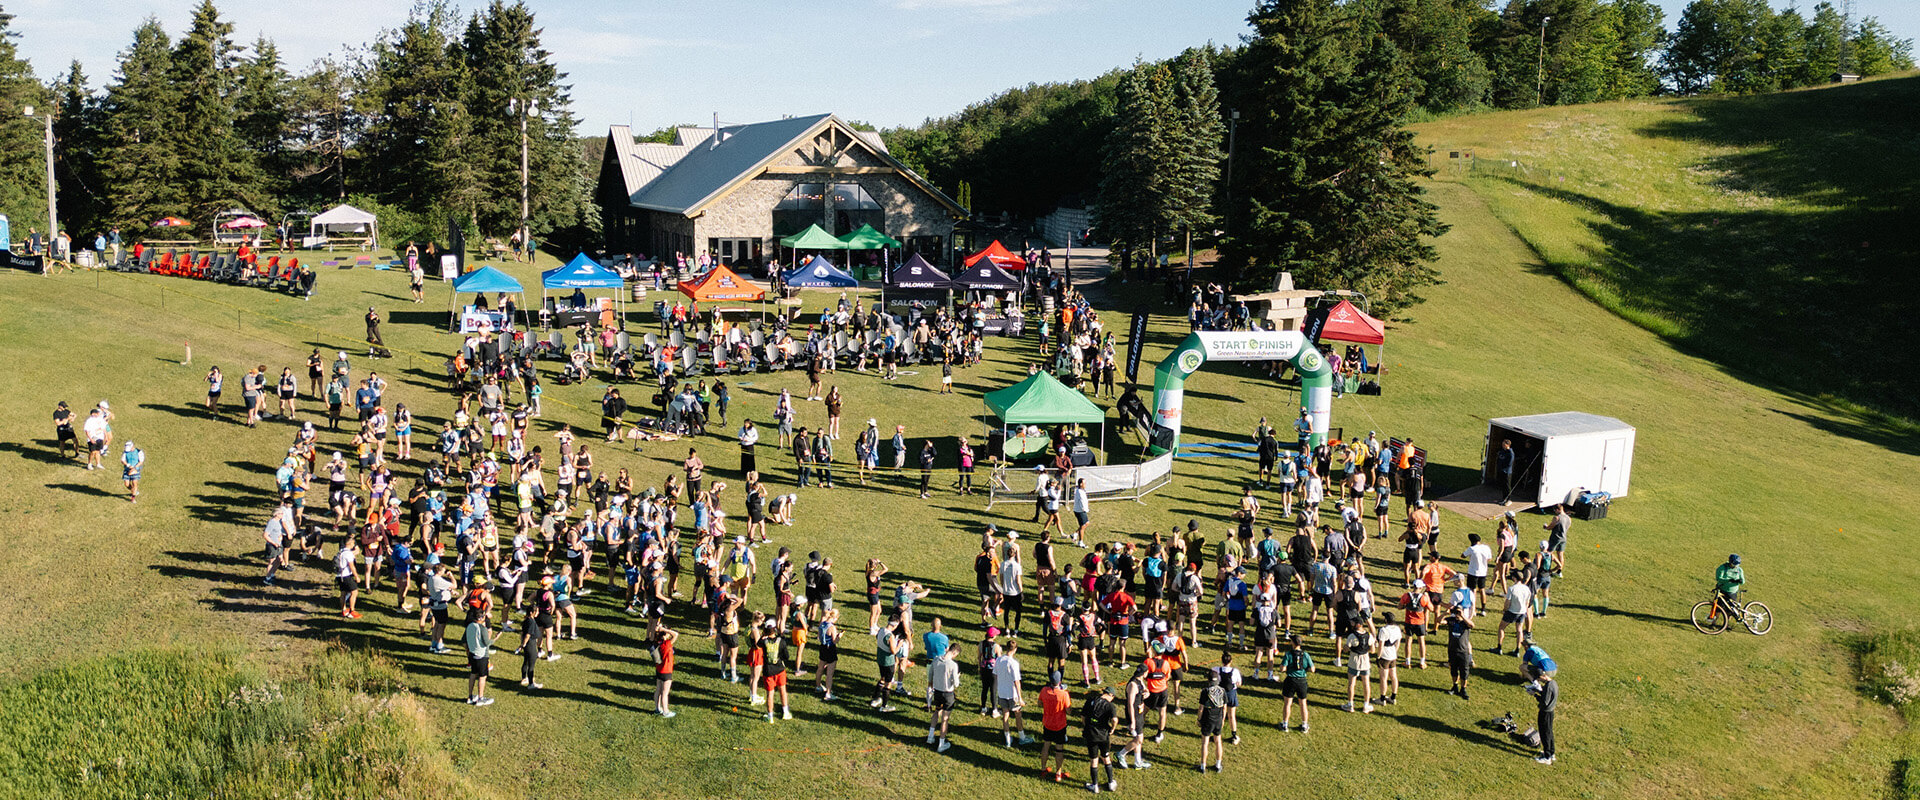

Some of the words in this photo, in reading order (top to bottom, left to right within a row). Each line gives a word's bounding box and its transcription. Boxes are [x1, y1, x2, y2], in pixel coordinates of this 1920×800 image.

[1129, 315, 1144, 376] SALOMON
[1213, 340, 1247, 350] START
[1259, 340, 1293, 350] FINISH
